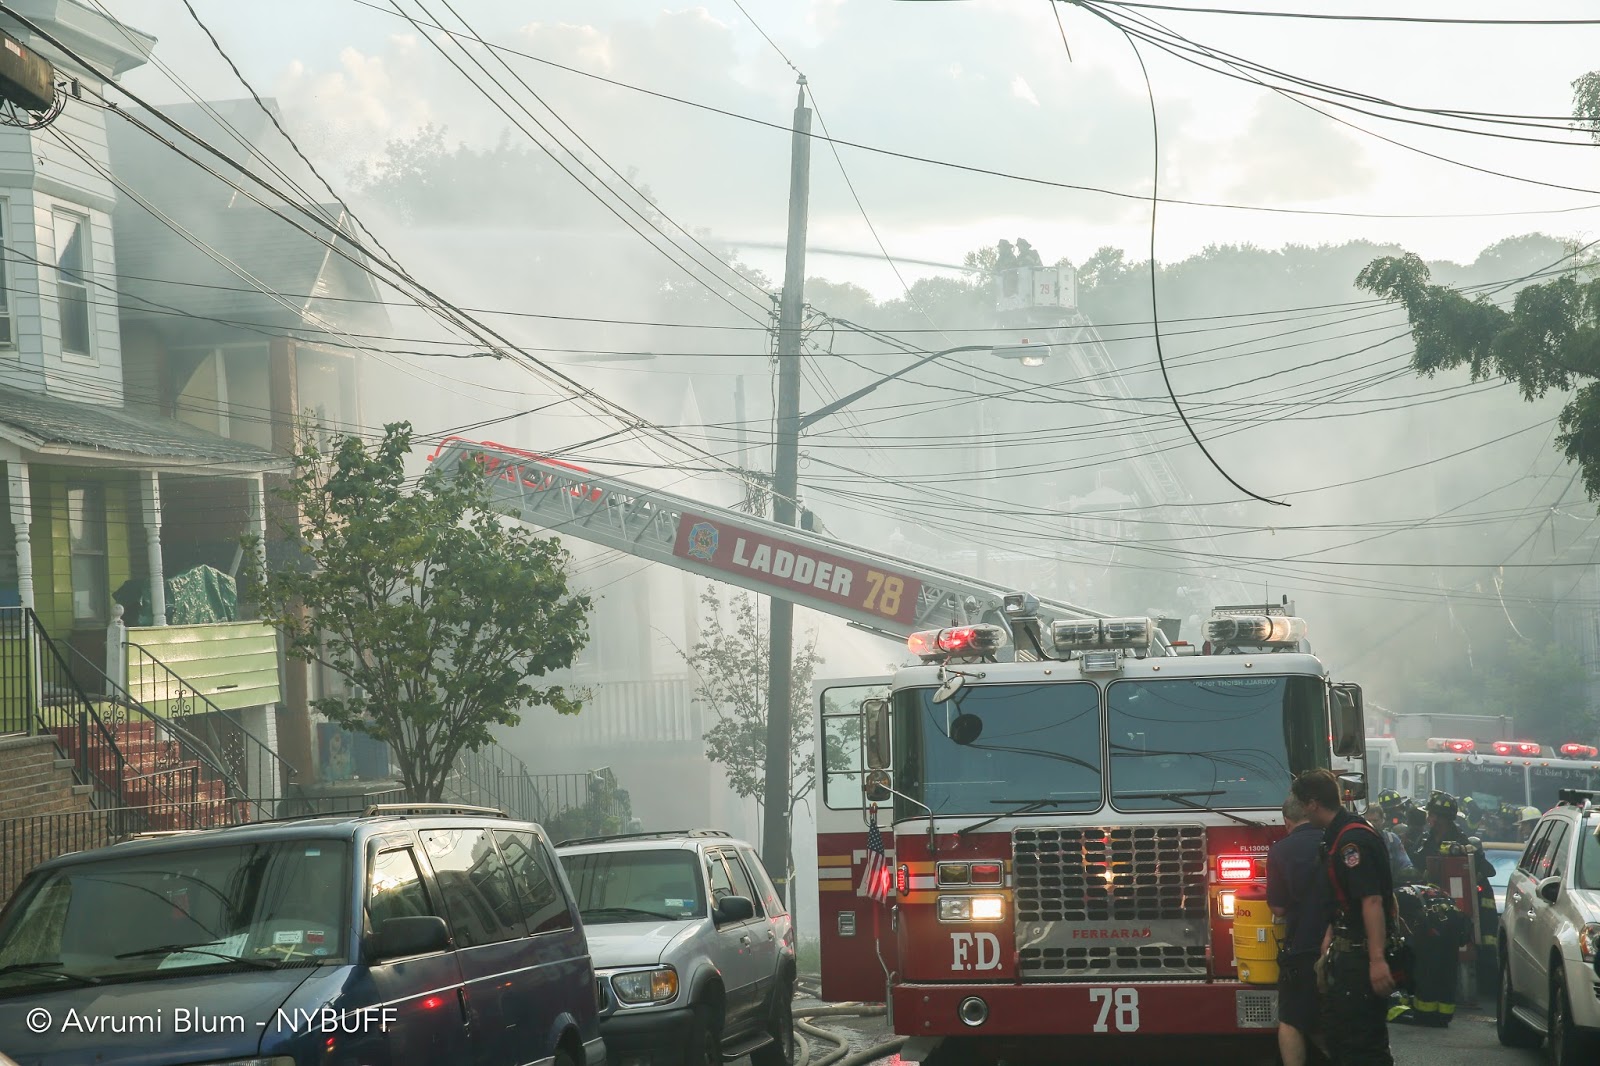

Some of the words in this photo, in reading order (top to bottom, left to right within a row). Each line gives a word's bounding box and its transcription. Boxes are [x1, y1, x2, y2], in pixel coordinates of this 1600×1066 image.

[732, 537, 854, 597] LADDER
[862, 570, 905, 616] 78
[950, 932, 1003, 971] F.D.
[1072, 929, 1140, 939] FERRARA
[1089, 987, 1140, 1033] 78
